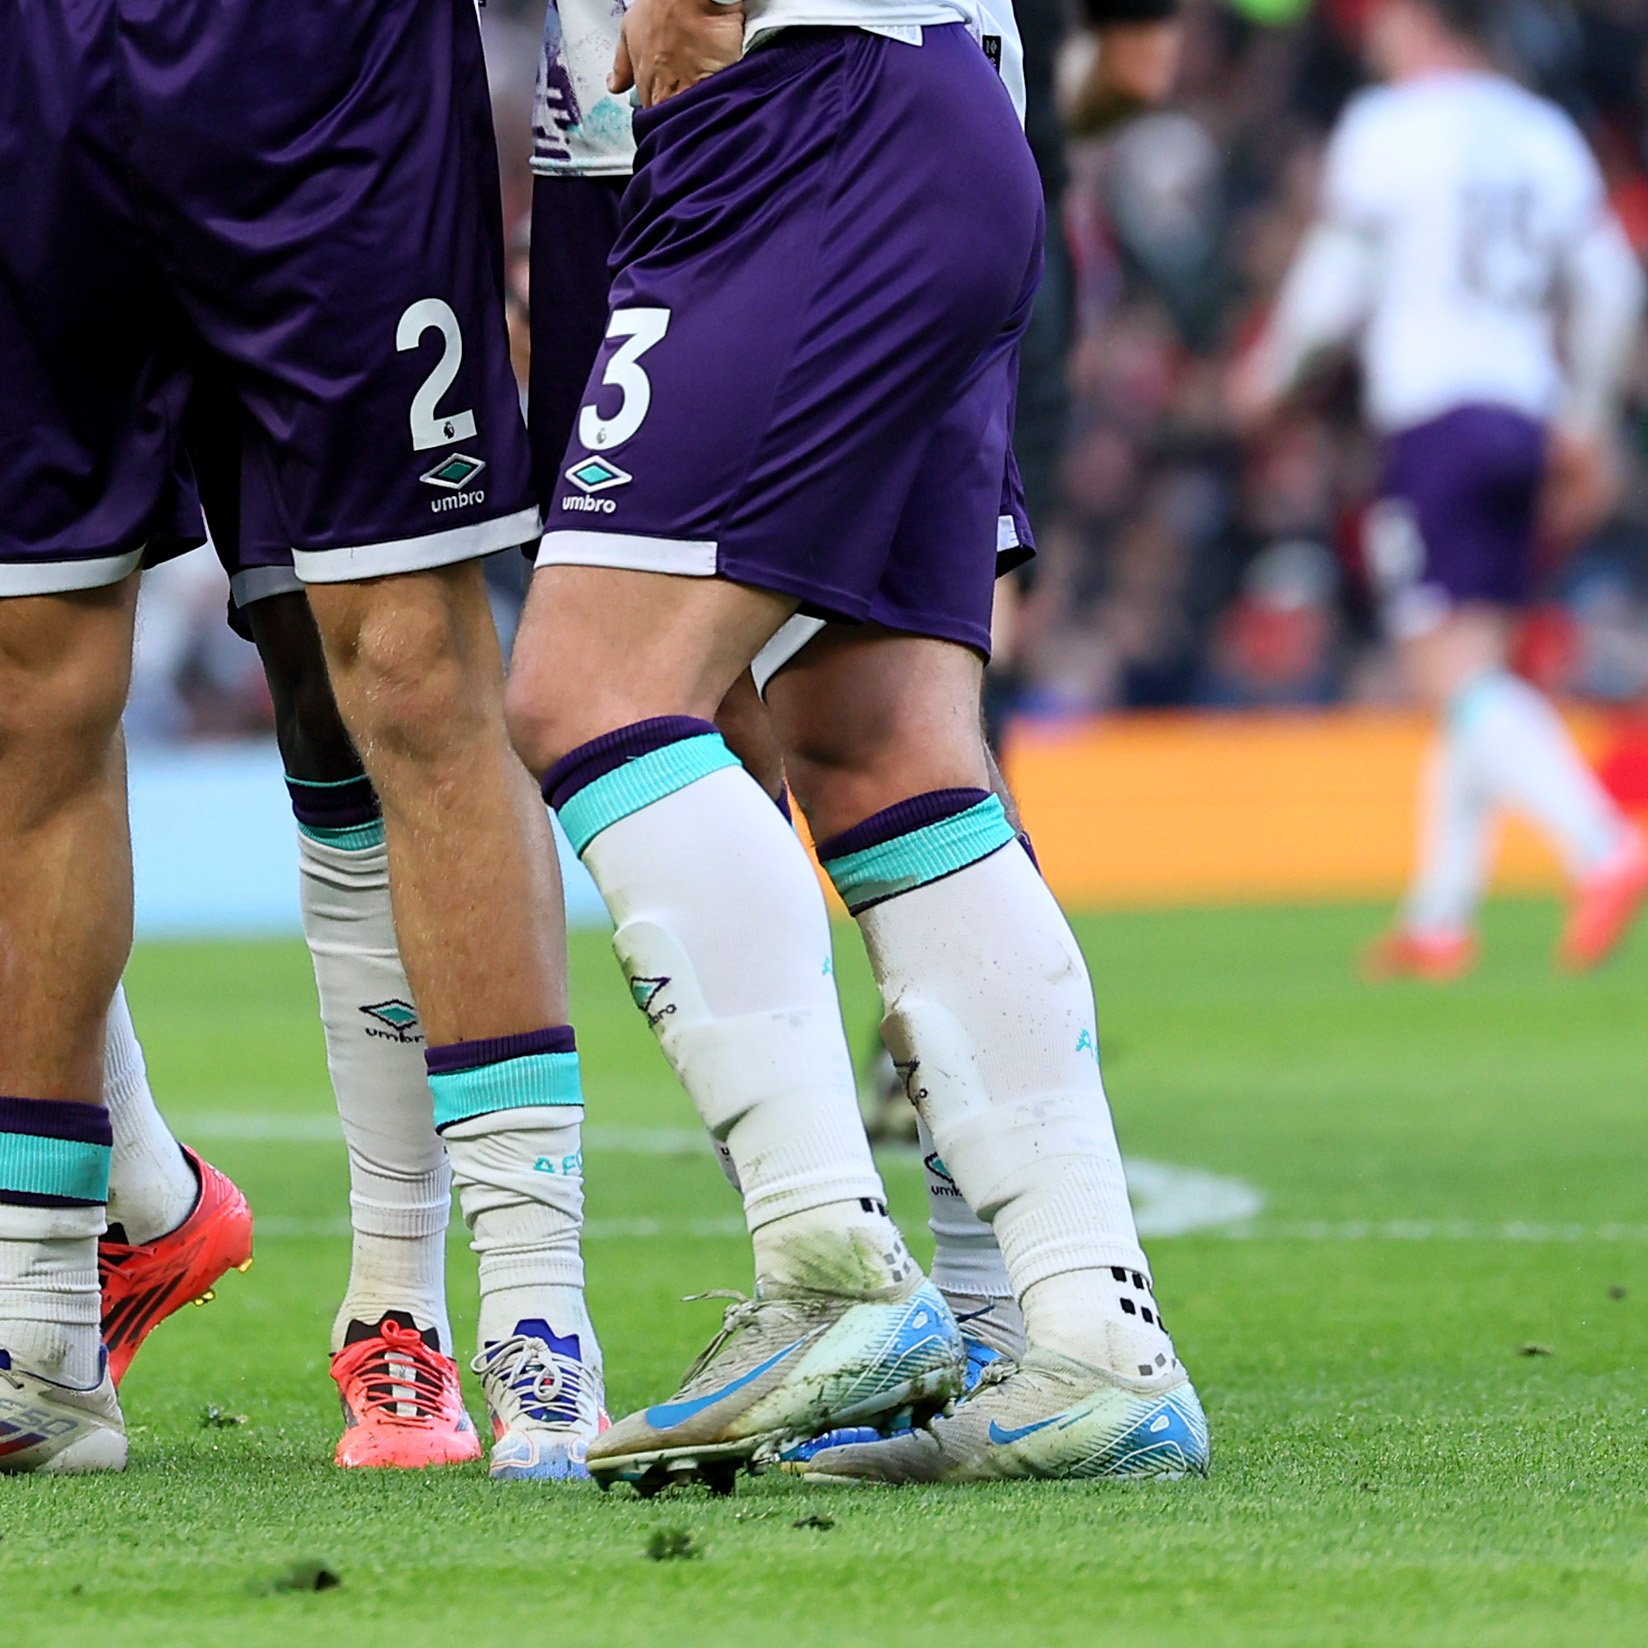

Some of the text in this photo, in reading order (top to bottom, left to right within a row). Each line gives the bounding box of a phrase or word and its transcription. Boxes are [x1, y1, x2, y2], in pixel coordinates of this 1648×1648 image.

[395, 298, 478, 452] 2
[578, 307, 672, 451] 3
[430, 488, 486, 514] umbro
[562, 494, 617, 515] umbro
[365, 1027, 425, 1043] umbr
